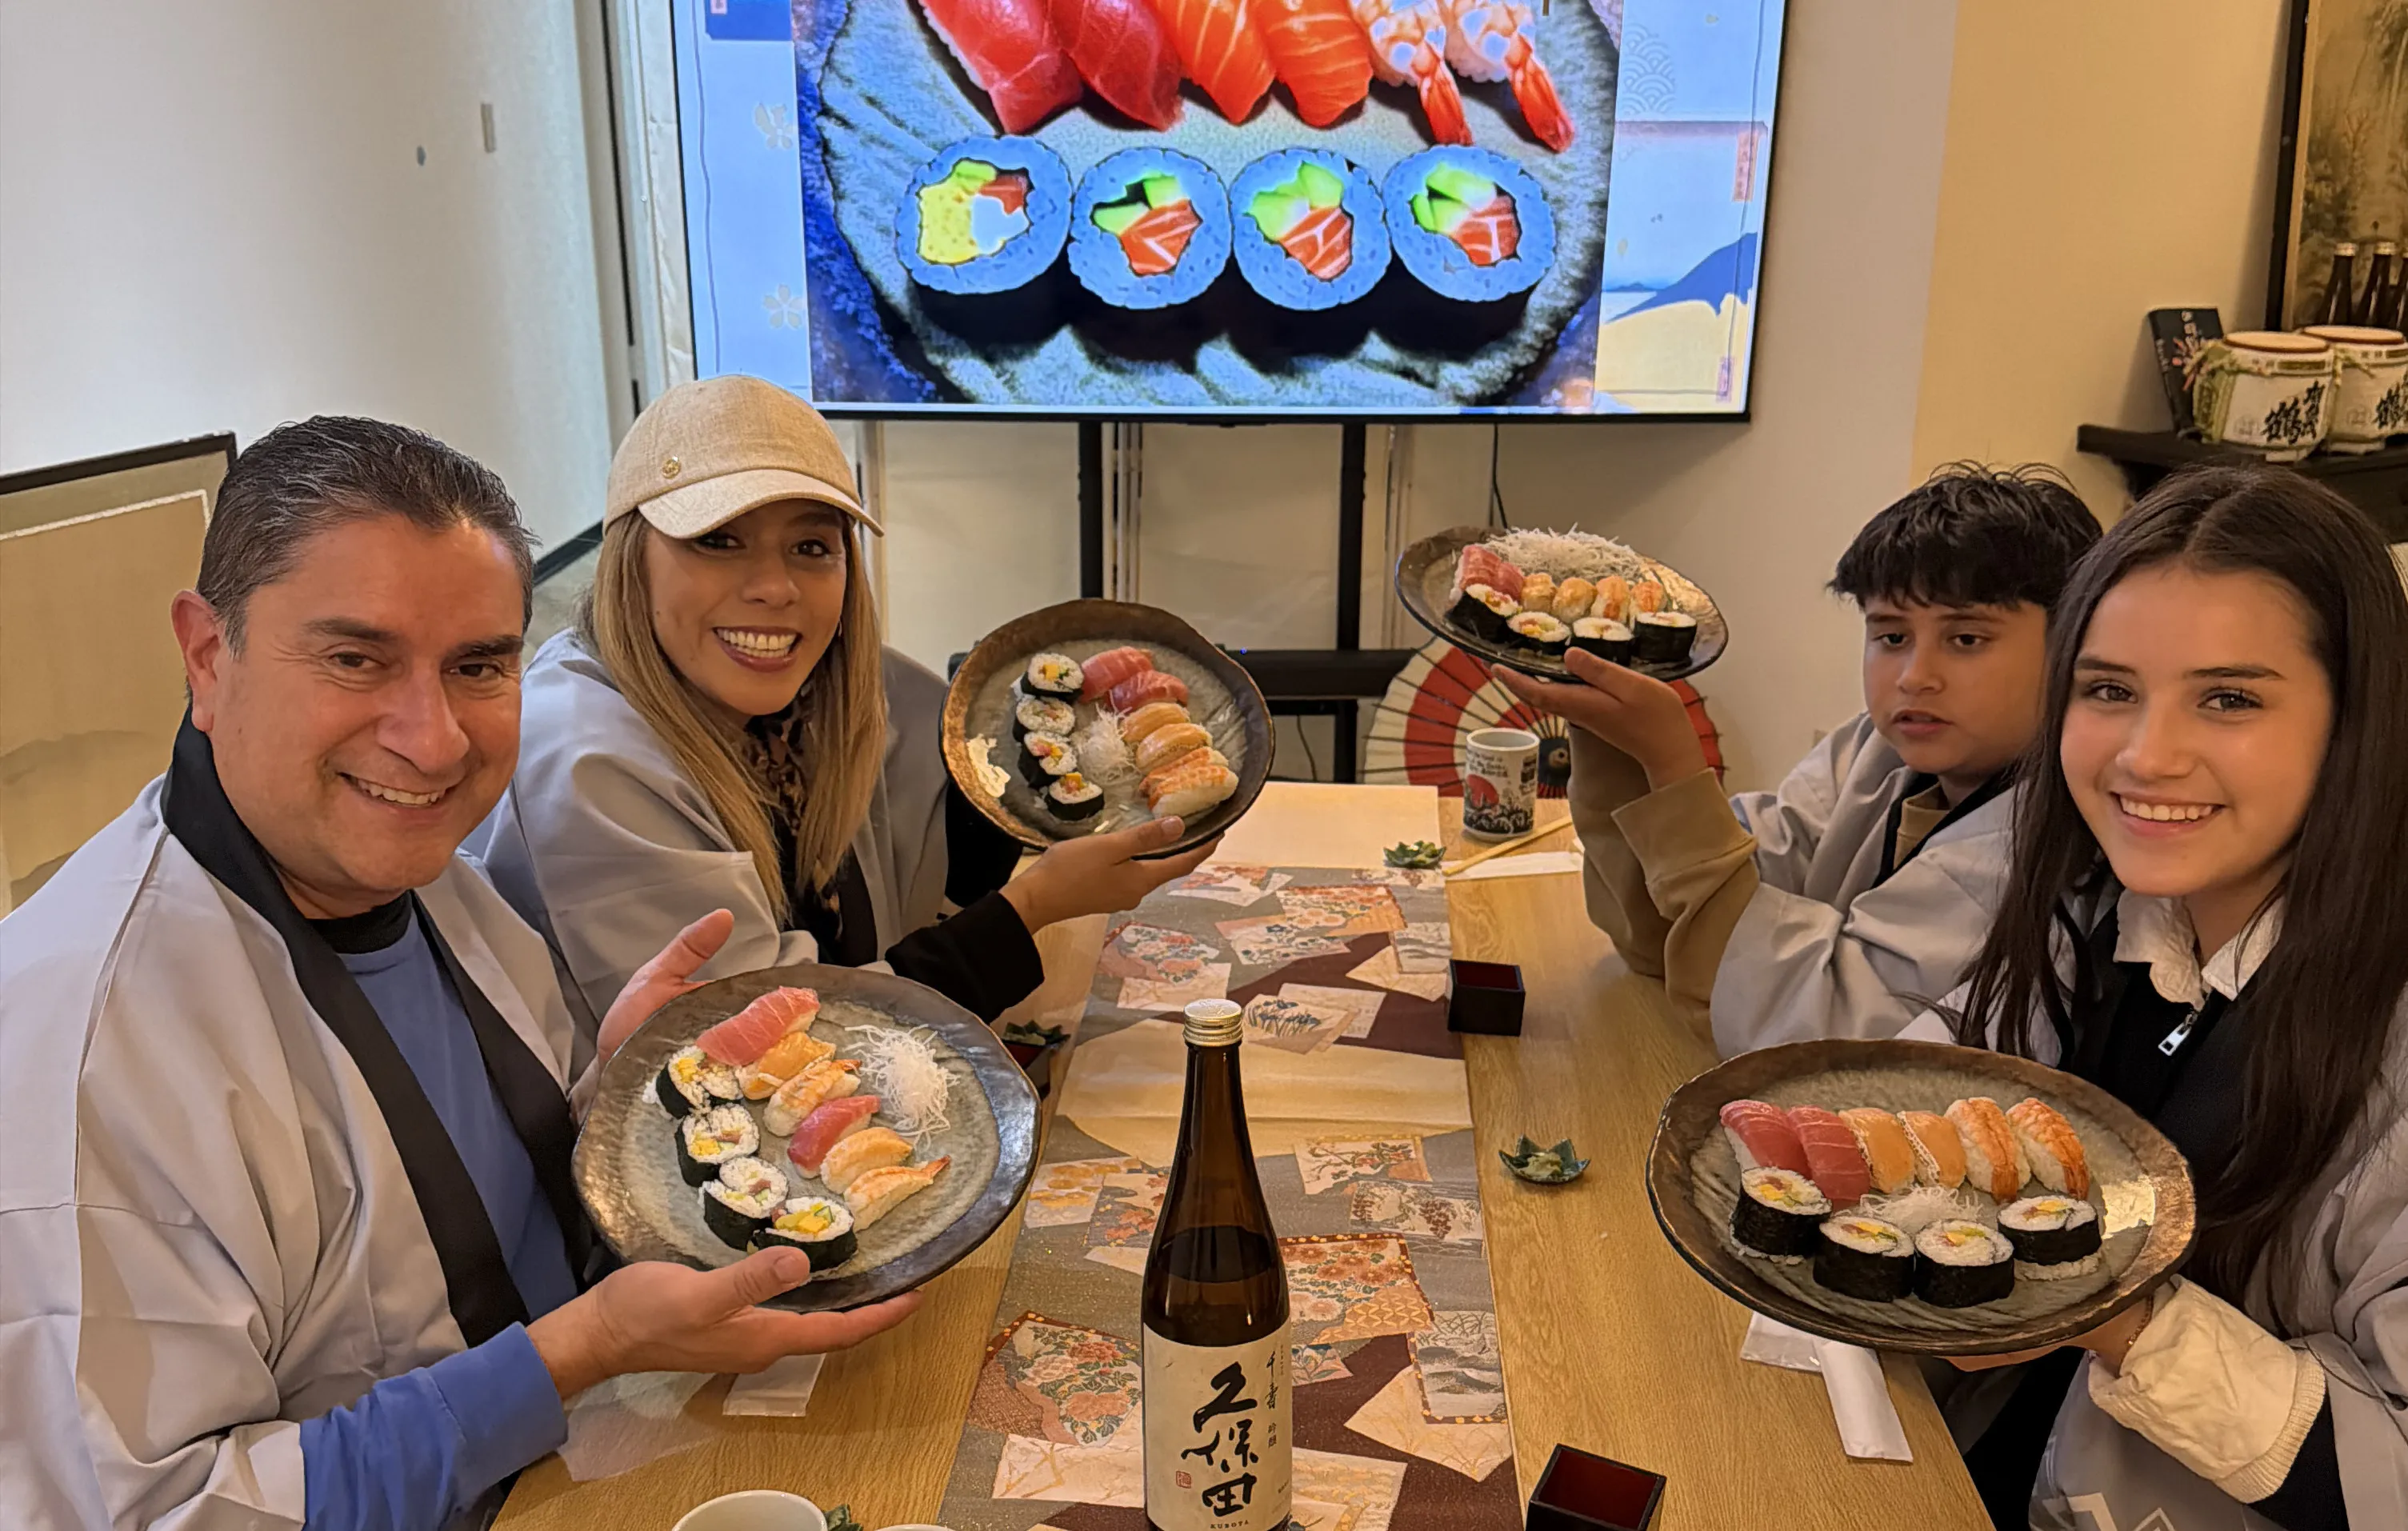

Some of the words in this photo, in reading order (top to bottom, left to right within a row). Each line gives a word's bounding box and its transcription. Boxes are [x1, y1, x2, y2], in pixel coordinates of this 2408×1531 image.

[1181, 1361, 1258, 1517] 久保田
[1210, 1520, 1249, 1529] KUBOTA
